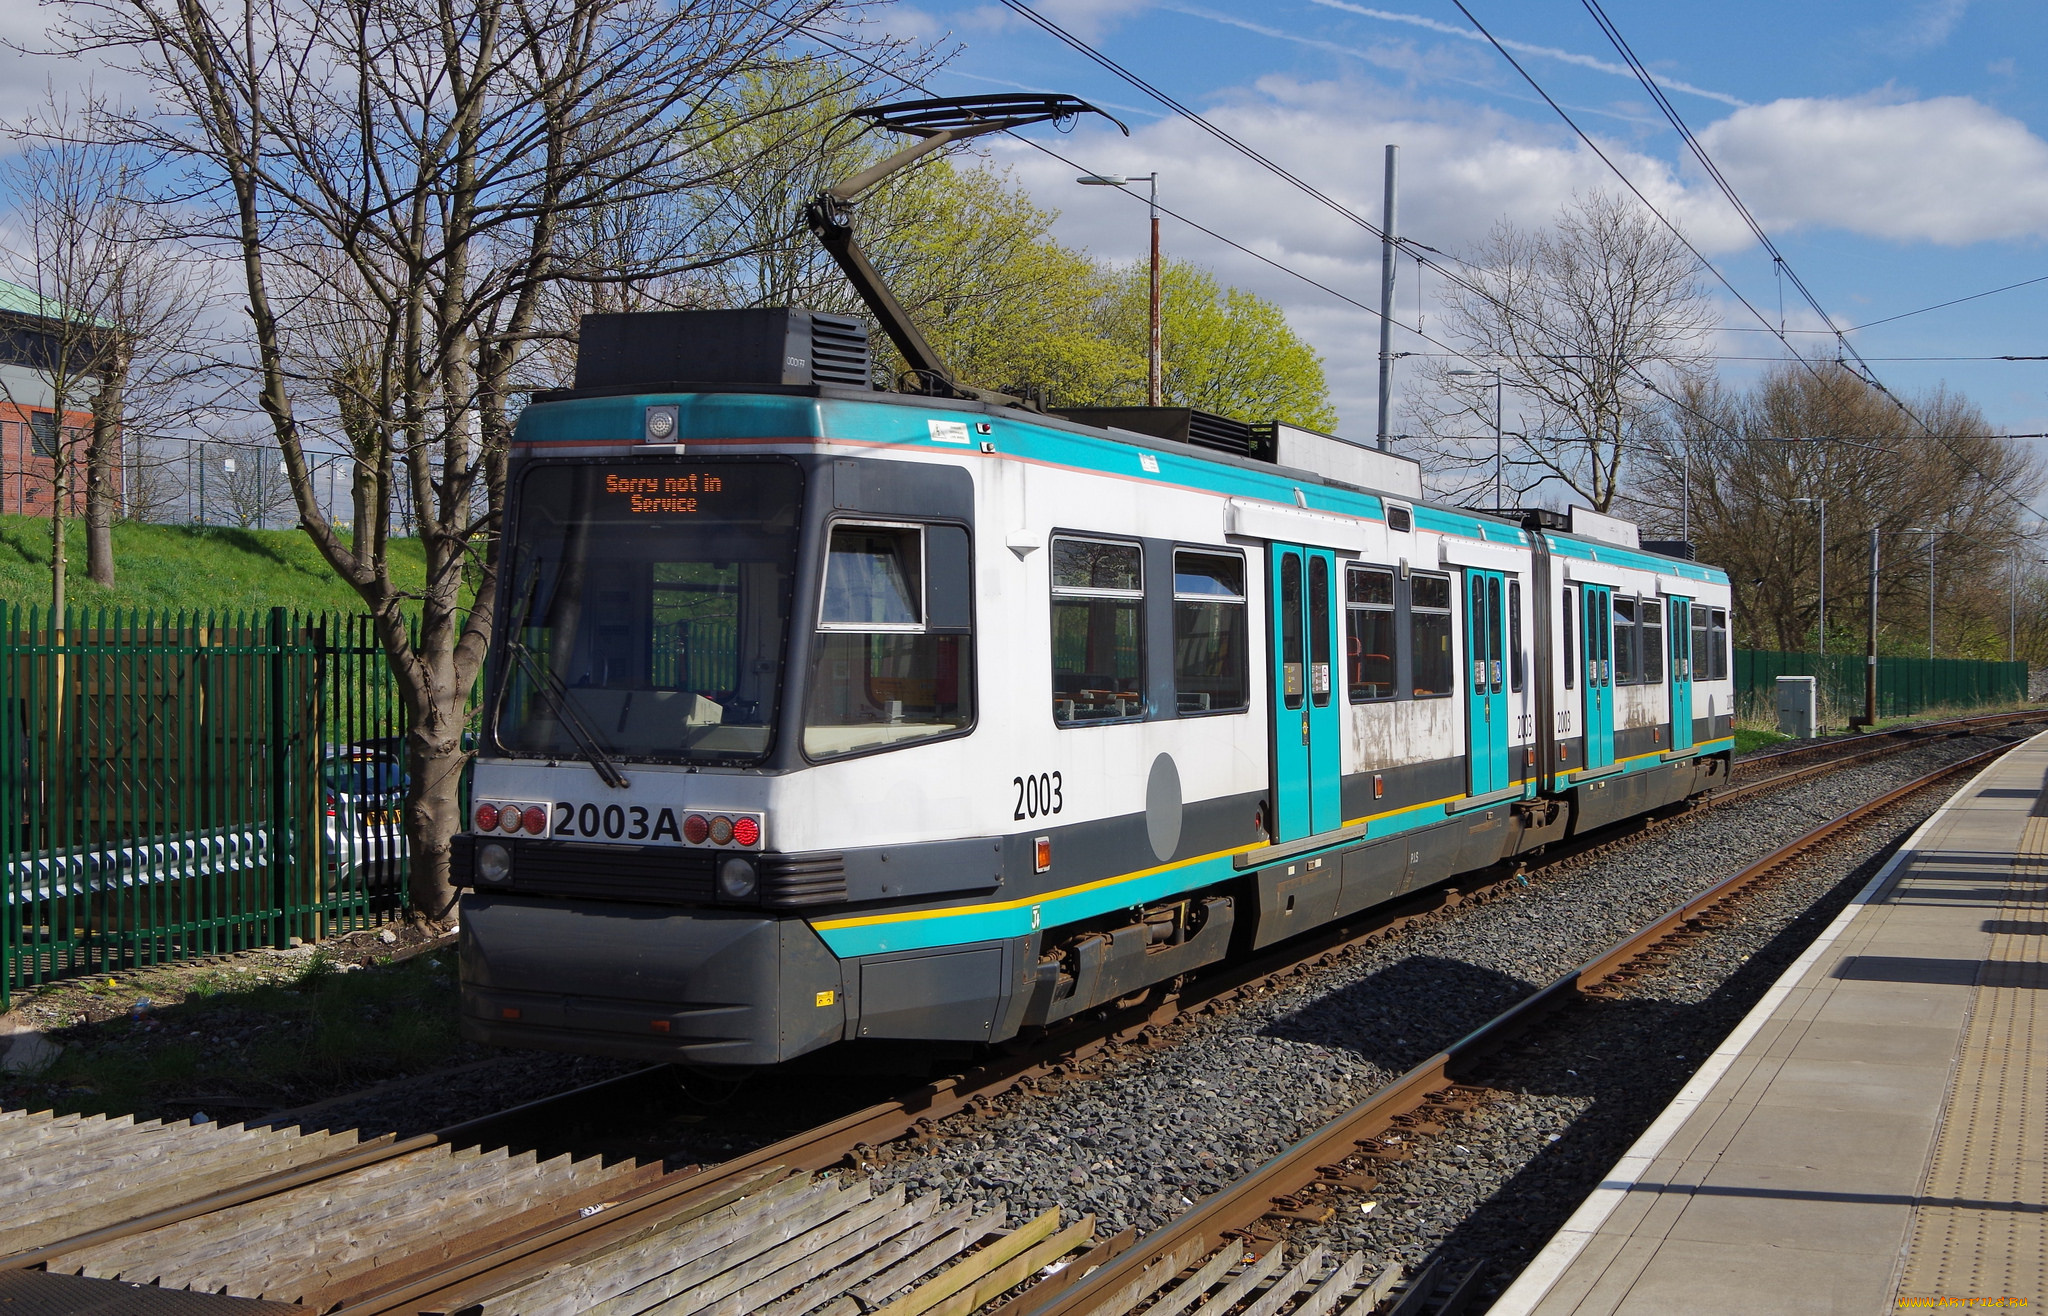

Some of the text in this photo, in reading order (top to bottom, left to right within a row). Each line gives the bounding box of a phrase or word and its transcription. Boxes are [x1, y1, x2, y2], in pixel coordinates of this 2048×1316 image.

[606, 473, 721, 492] Sorry not in
[631, 494, 697, 512] Service
[1517, 713, 1533, 739] 2003
[1557, 710, 1571, 733] 2003
[1013, 770, 1063, 821] 2003
[554, 802, 682, 842] 2003A
